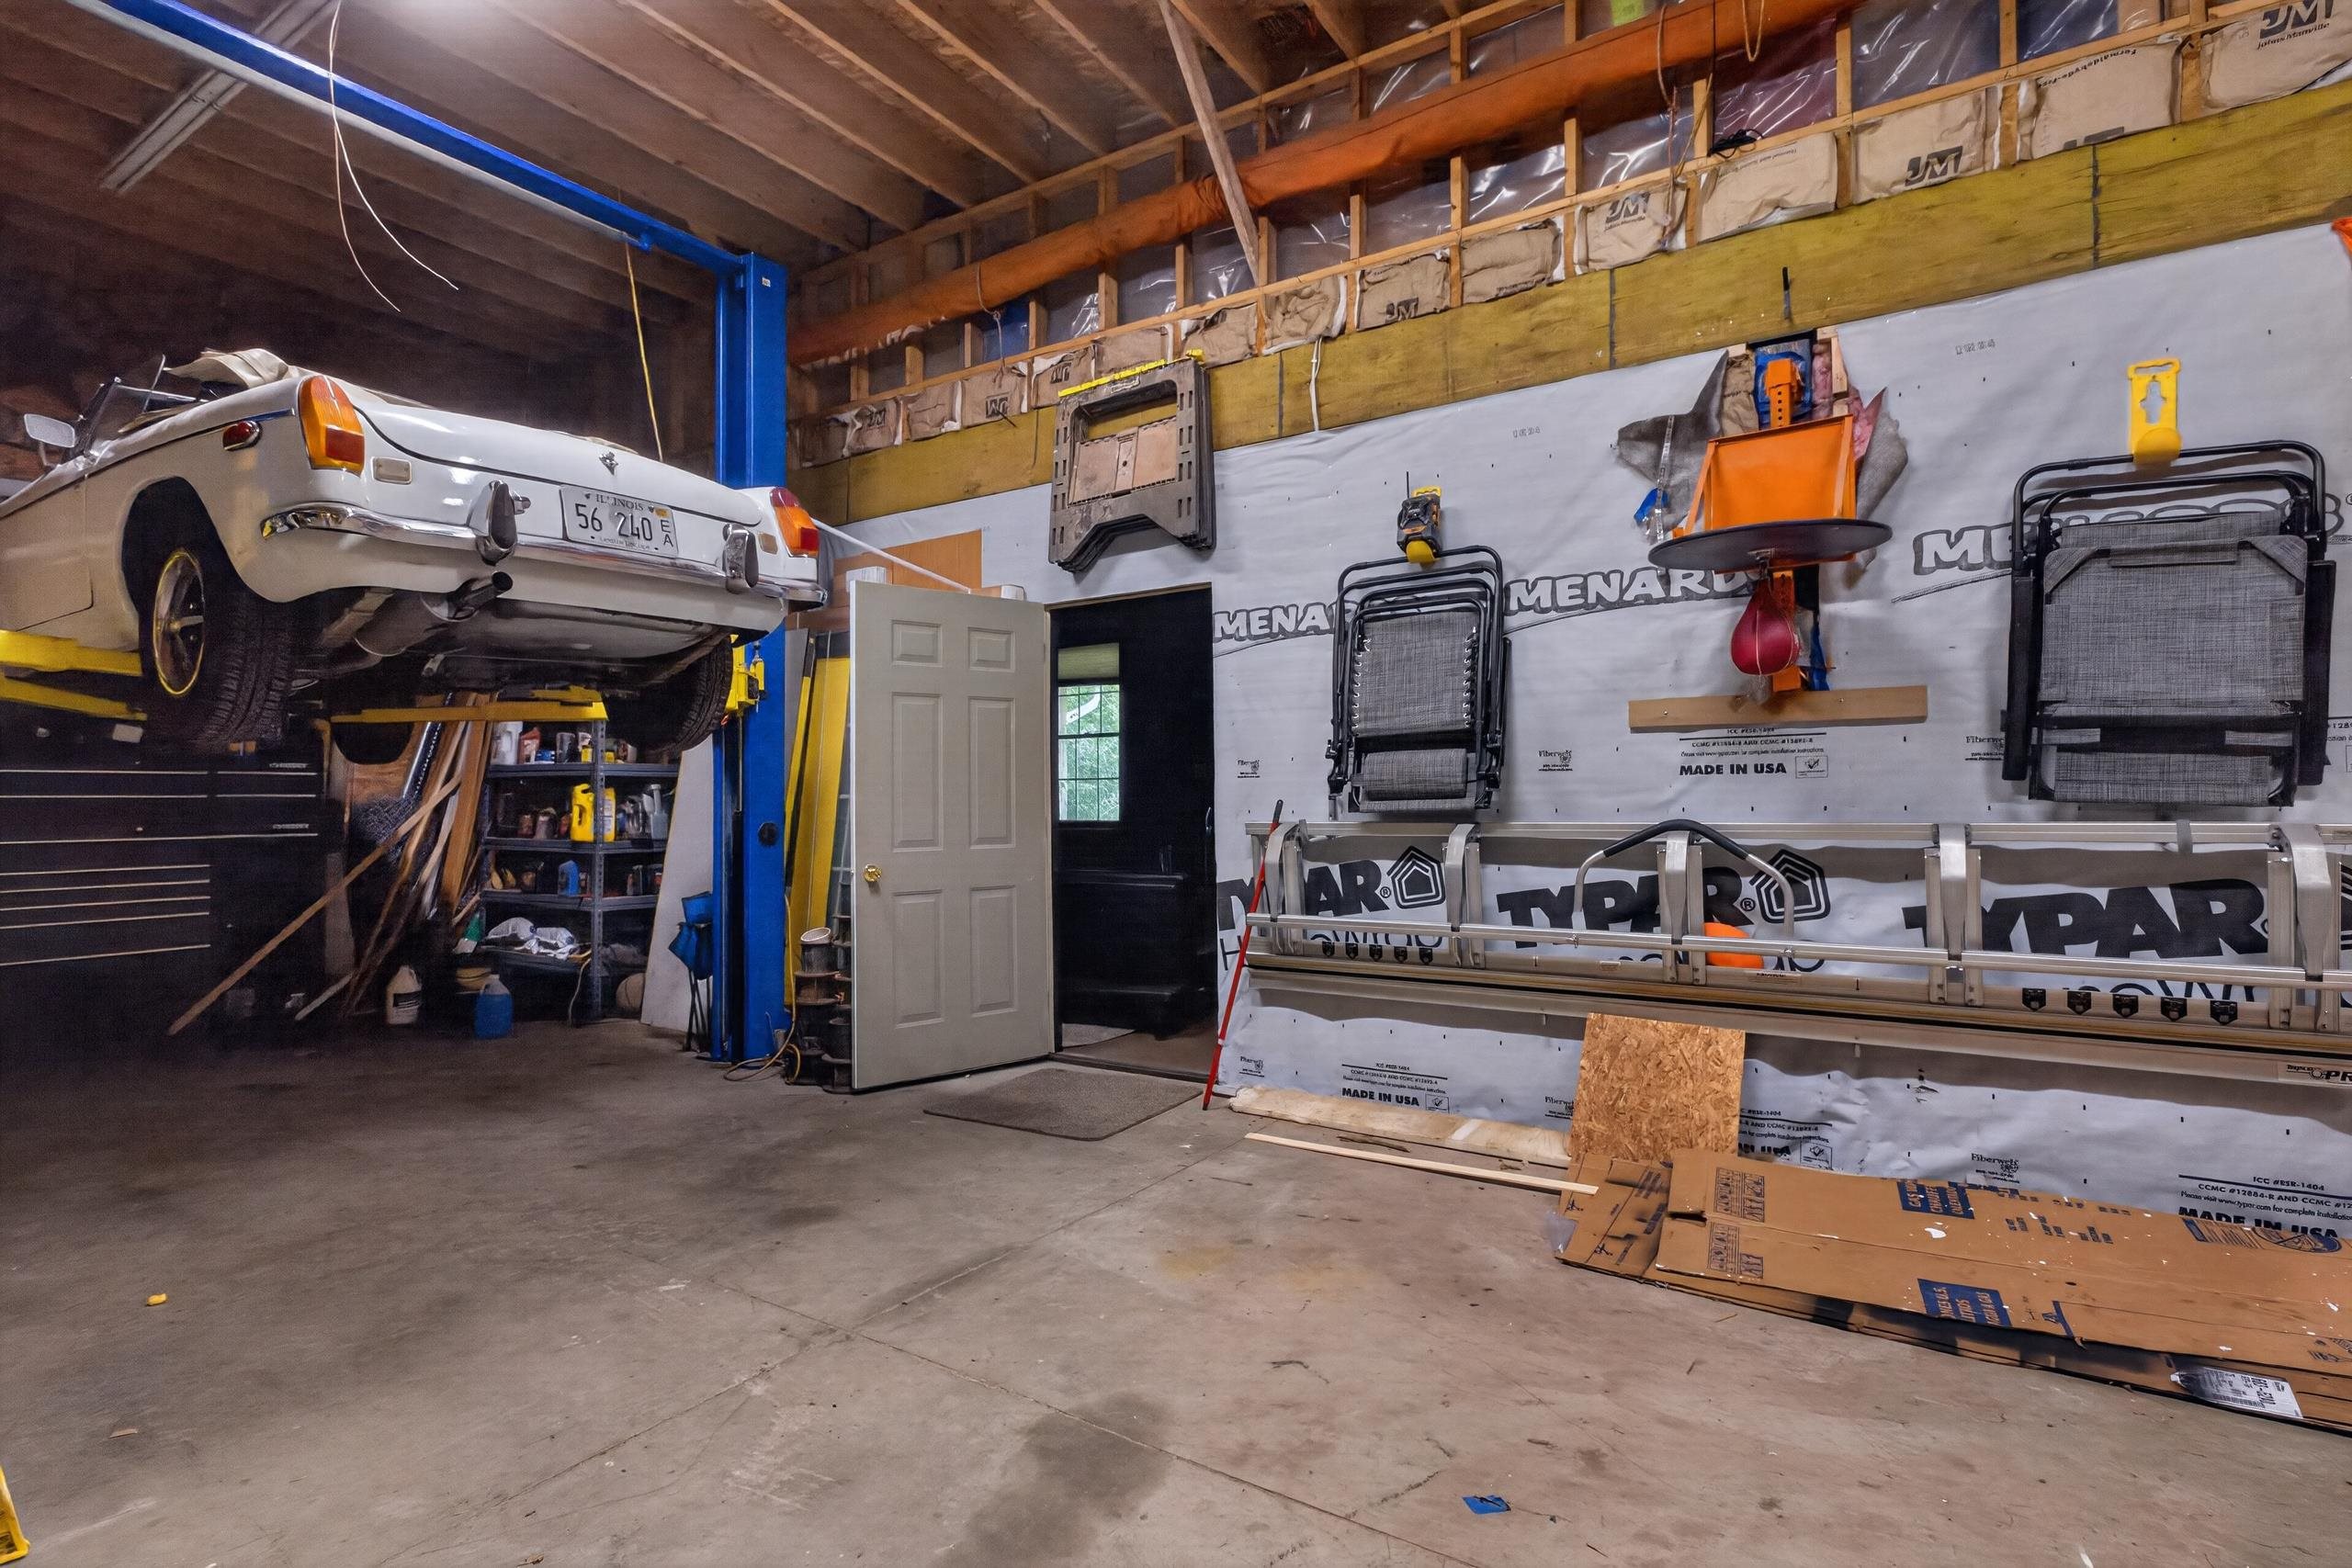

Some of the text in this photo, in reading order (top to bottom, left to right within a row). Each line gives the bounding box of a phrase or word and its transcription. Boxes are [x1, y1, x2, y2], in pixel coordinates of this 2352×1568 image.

[1904, 145, 1962, 186] JM
[575, 502, 653, 541] 56 240
[1503, 567, 1759, 615] MENARD
[1679, 762, 1787, 776] MADE IN USA
[1902, 878, 2269, 959] YPAR
[1342, 1087, 1419, 1106] MADE IN USA
[2198, 1183, 2226, 1193] CCMC
[2277, 1194, 2299, 1202] AND
[2301, 1197, 2332, 1207] CCMC
[2253, 1176, 2270, 1185] ICC
